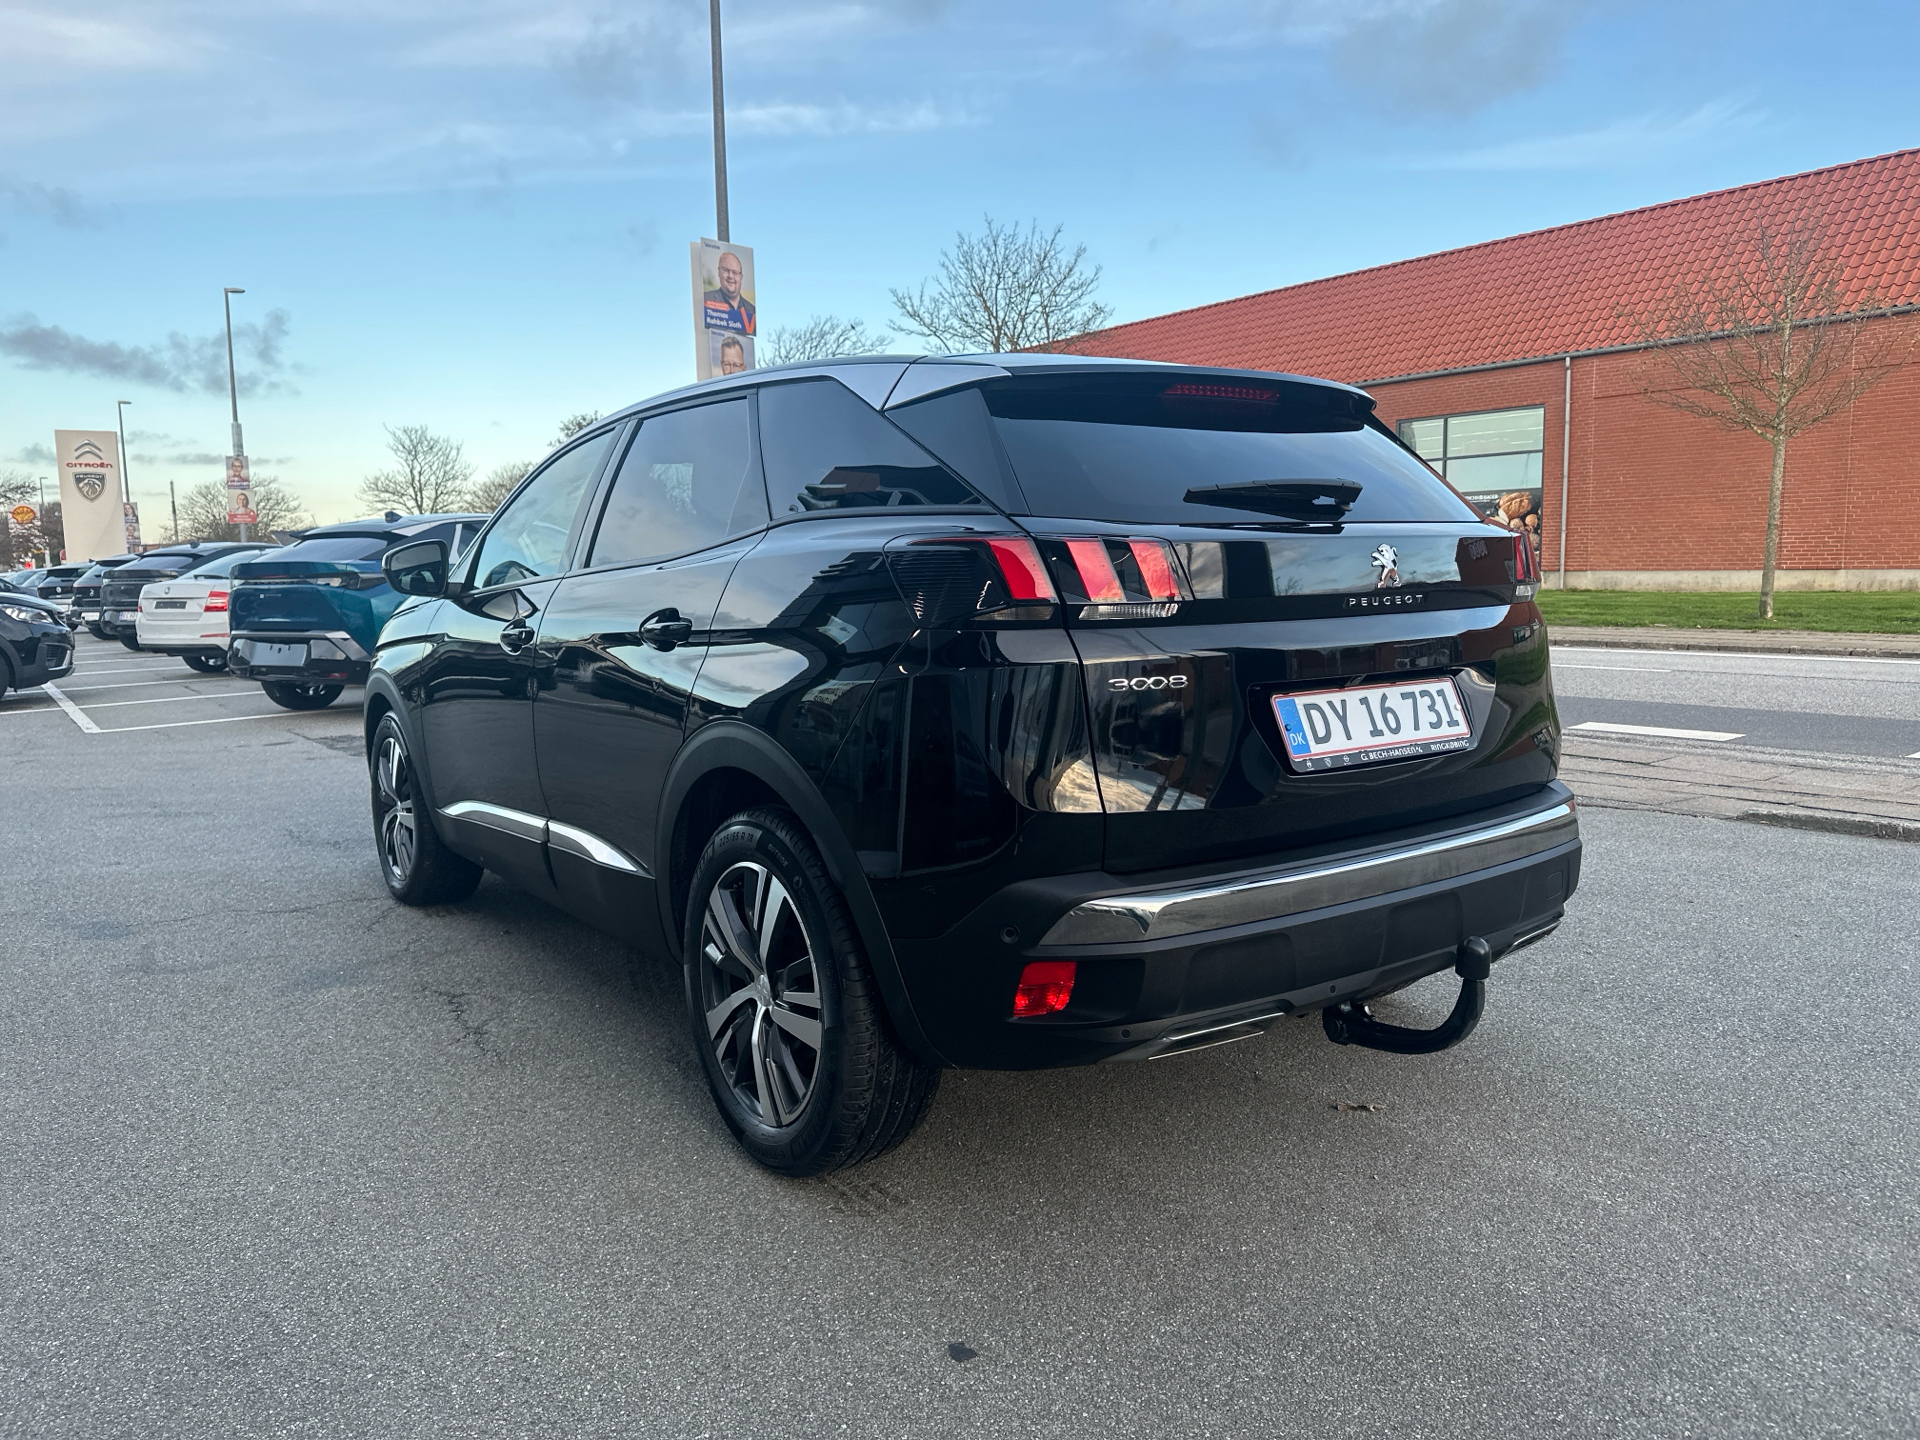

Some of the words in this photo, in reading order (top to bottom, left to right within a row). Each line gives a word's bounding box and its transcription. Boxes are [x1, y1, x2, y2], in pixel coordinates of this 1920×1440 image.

[706, 309, 729, 319] Thomas
[740, 307, 755, 334] V
[706, 317, 728, 327] Rahbek
[728, 320, 742, 329] Sloth
[66, 461, 113, 469] CITROËN
[1349, 594, 1423, 607] PEUGEOT
[1107, 675, 1189, 692] 3008
[1303, 699, 1353, 745] DY
[1358, 691, 1401, 738] 16
[1400, 688, 1460, 731] 731
[1289, 731, 1306, 746] DK
[767, 842, 789, 868] OUTSIDE
